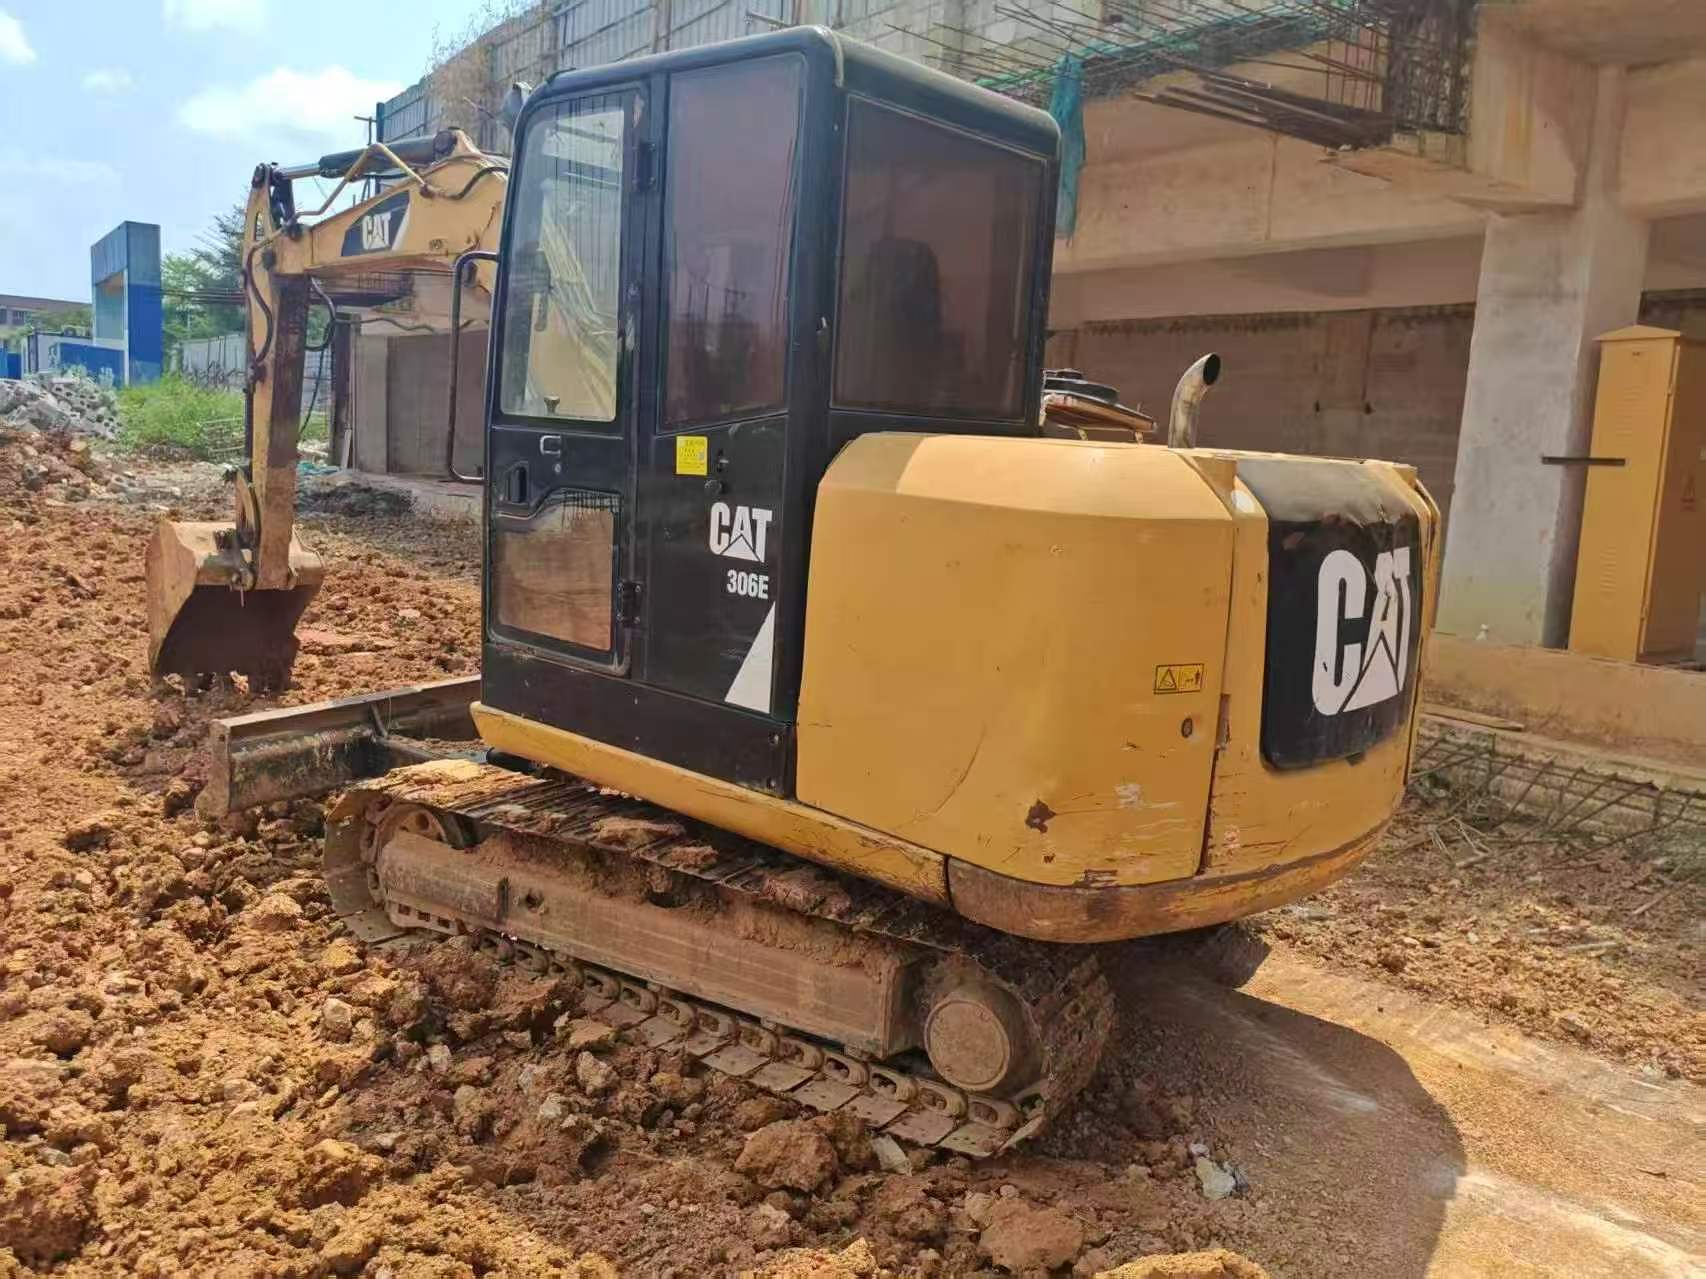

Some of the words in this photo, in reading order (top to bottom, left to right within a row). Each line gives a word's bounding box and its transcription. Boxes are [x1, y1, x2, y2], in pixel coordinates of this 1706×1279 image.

[362, 211, 391, 250] CAT
[709, 502, 773, 563] CAT
[727, 569, 769, 600] 306E
[1312, 546, 1411, 716] CAT
